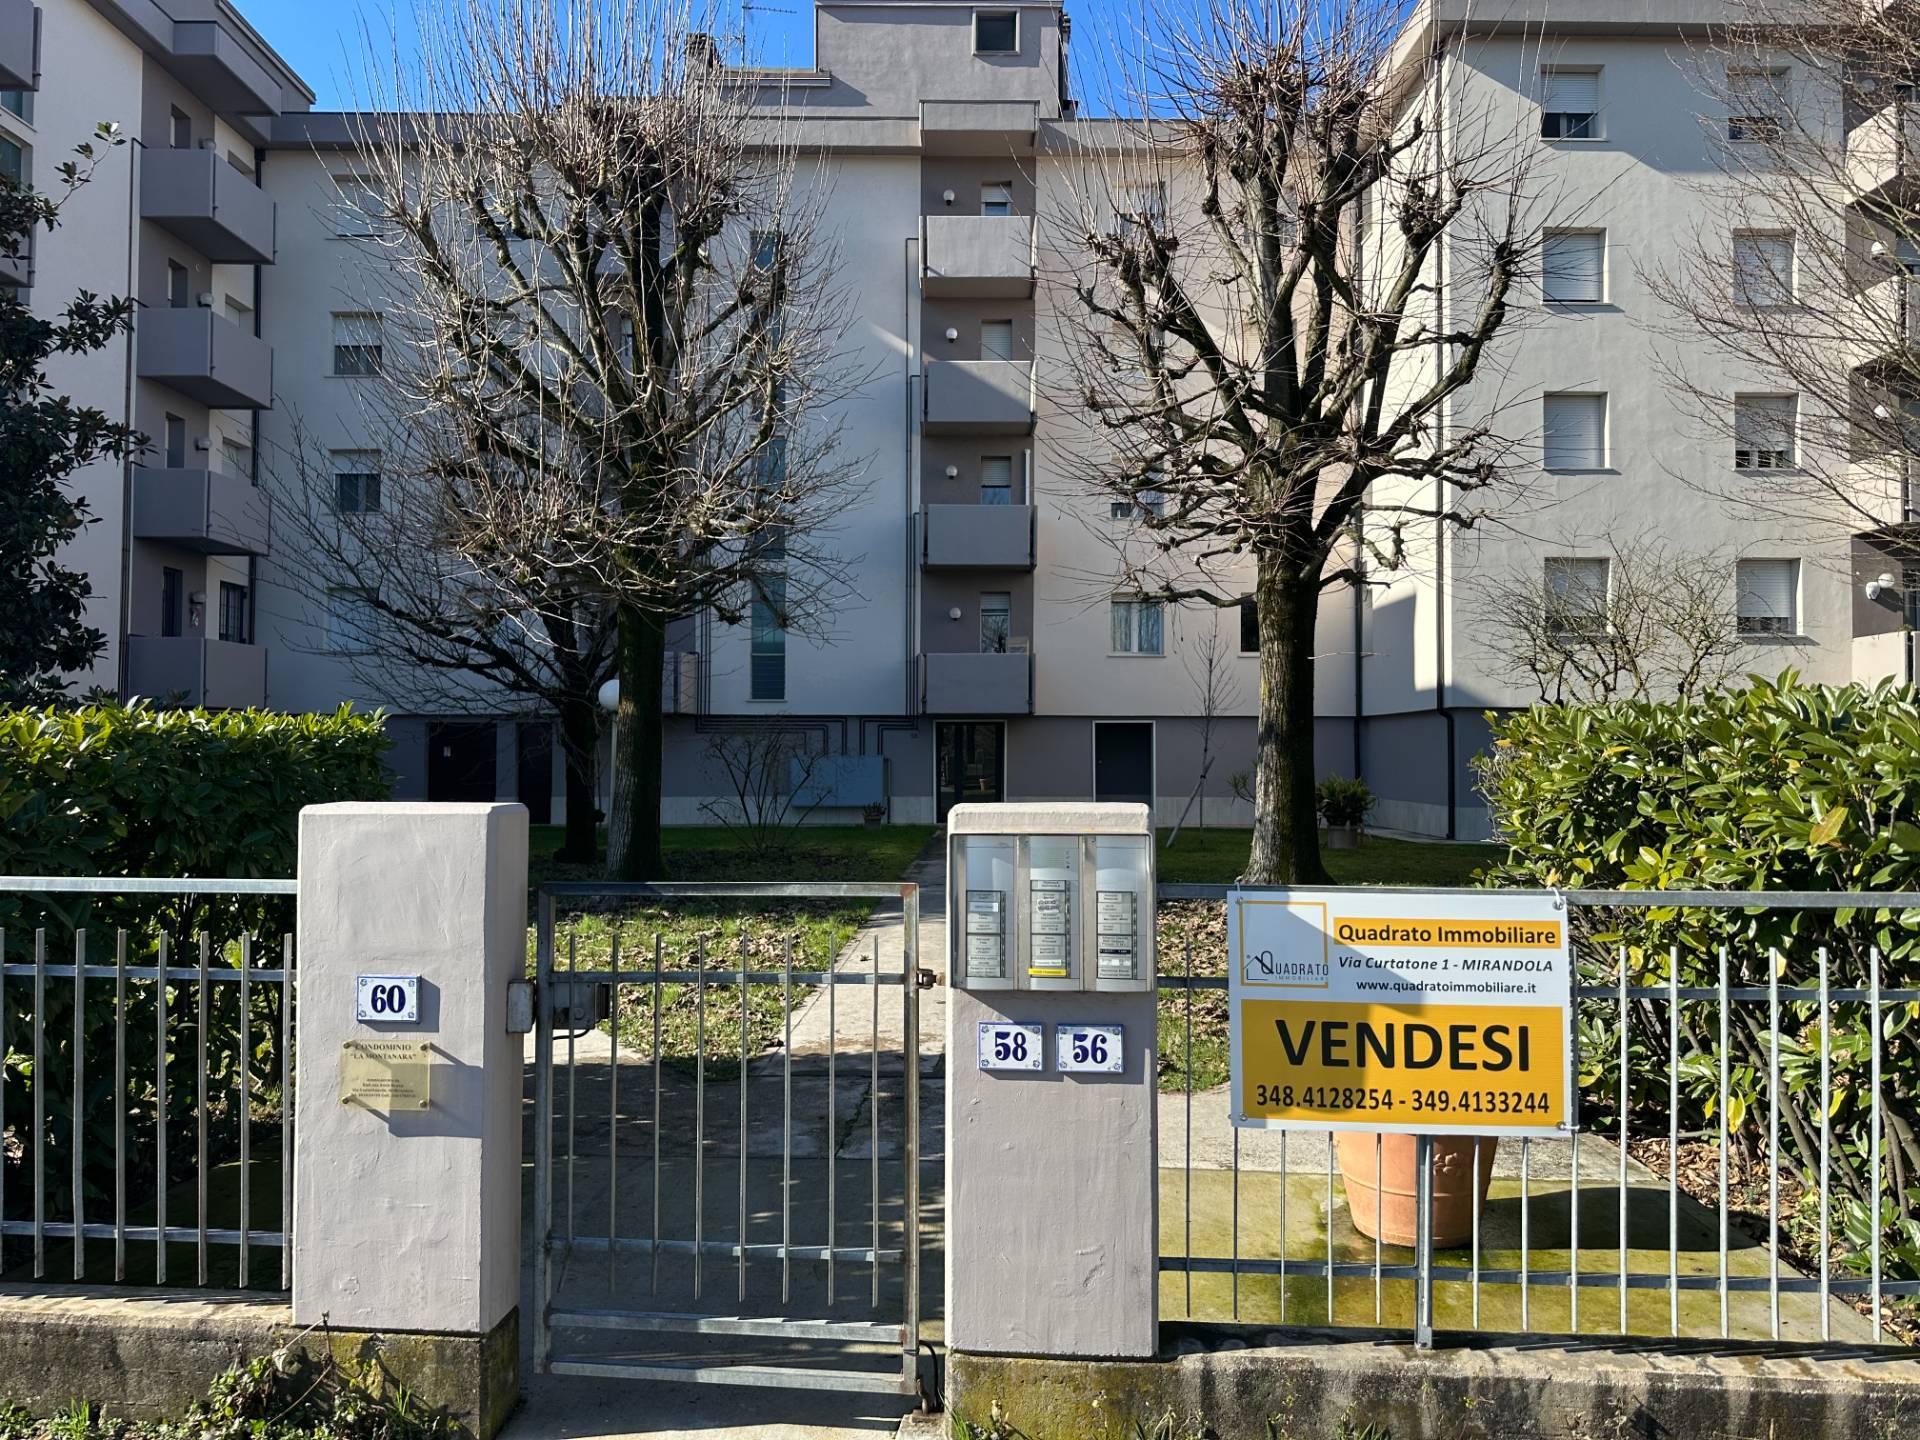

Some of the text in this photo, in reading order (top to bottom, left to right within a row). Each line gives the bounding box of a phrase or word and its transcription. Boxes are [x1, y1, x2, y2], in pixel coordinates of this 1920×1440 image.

[1338, 924, 1556, 944] Quadrato Immobiliare
[1258, 950, 1329, 976] QUADRATO
[1339, 956, 1362, 969] Via
[1365, 957, 1438, 971] Curtatone
[1442, 959, 1449, 970] 1
[1461, 959, 1553, 972] MIRANDOLA
[371, 984, 406, 1013] 60
[1356, 980, 1537, 994] www.quadratoimmobiliare.it
[355, 1043, 412, 1051] CONDOMINIO
[994, 1031, 1108, 1064] 58 56
[1275, 1019, 1530, 1072] VENDESI
[1256, 1084, 1394, 1111] 348.4128254
[1411, 1090, 1550, 1114] 349.4133244
